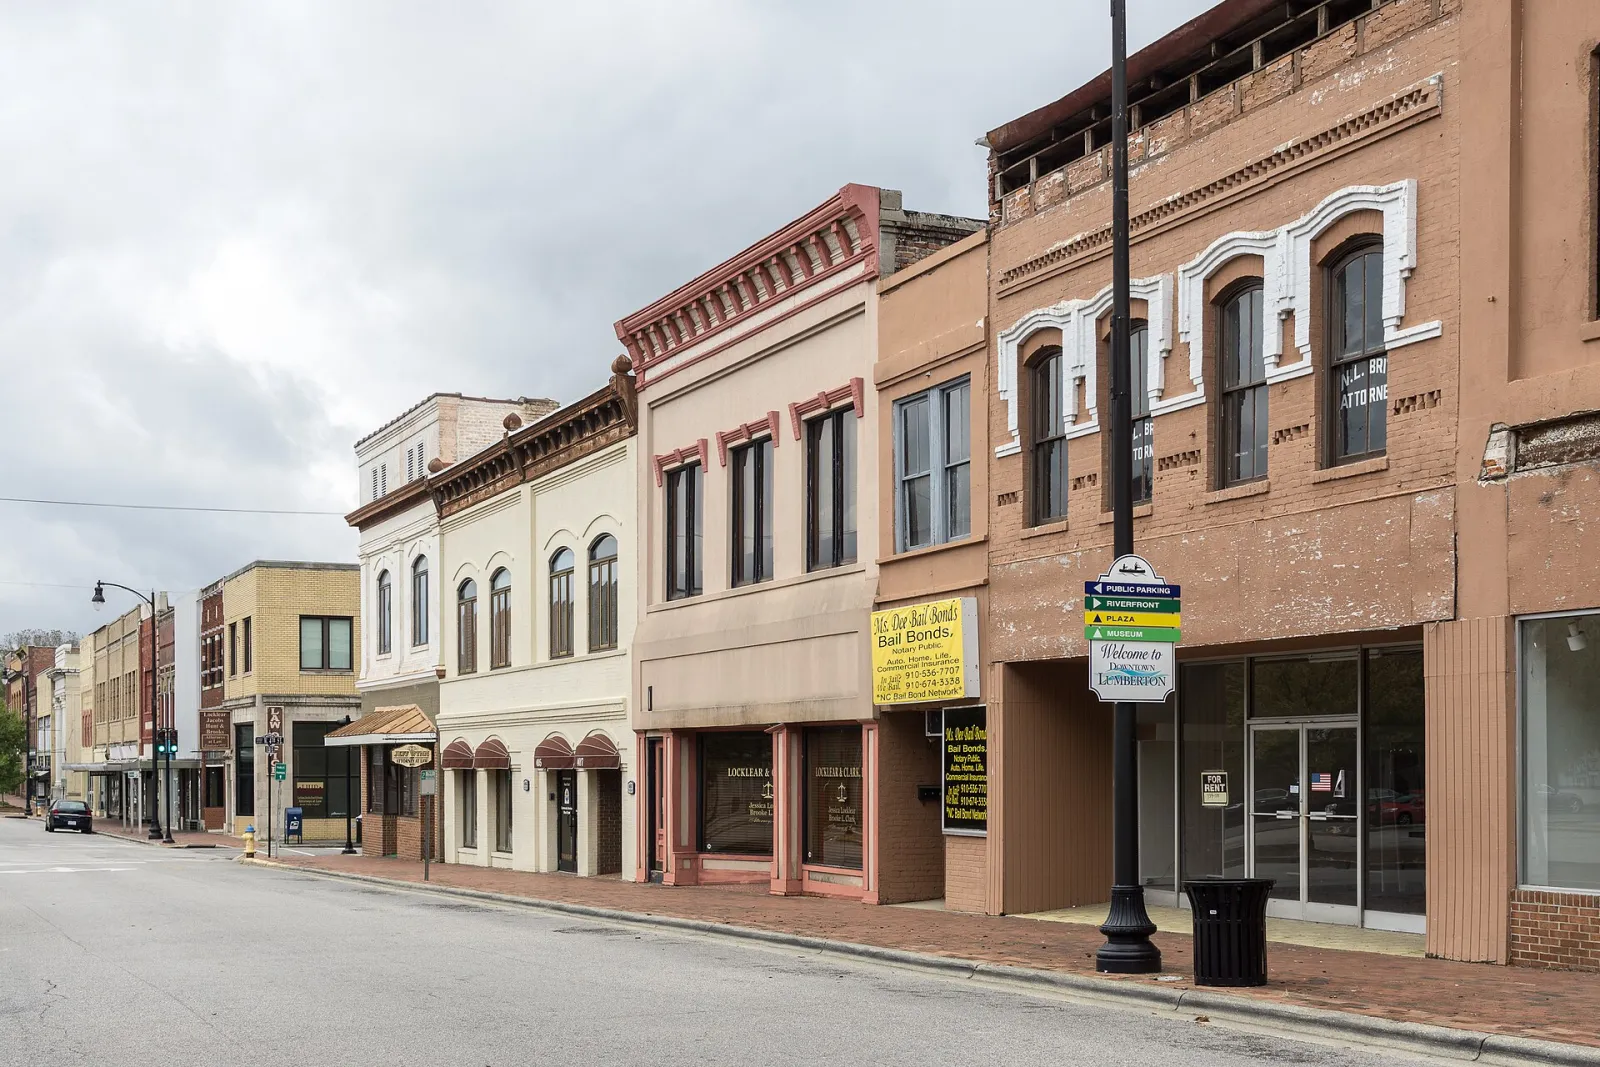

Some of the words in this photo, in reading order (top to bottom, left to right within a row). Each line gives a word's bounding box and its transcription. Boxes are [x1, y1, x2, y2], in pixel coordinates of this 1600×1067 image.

[1369, 358, 1388, 374] BRI
[1340, 384, 1388, 410] ATTORNE
[1136, 586, 1171, 594] PARKING
[1106, 600, 1160, 608] RIVERFRONT
[874, 617, 889, 636] Ms.
[892, 614, 908, 631] Dee
[909, 605, 930, 628] Bail
[930, 600, 958, 625] Bonds
[878, 633, 902, 648] Bail
[906, 626, 954, 644] Bonds,
[1106, 630, 1143, 638] MUSEUM
[892, 646, 917, 656] Notary
[1100, 644, 1149, 660] Welcome
[1150, 648, 1162, 660] to
[876, 662, 920, 673] Commercial
[922, 658, 960, 668] Insurance
[1110, 662, 1156, 671] DOWNTOWN
[905, 666, 960, 679] 910-536-7707
[906, 676, 961, 690] 910-674-3338
[1098, 672, 1166, 686] LUMBERTON
[893, 692, 906, 700] Bail
[908, 690, 926, 698] Bond
[270, 708, 281, 729] LAW
[948, 744, 961, 753] Bail
[954, 754, 966, 764] Notary
[728, 767, 763, 777] LOCKLEAR
[764, 767, 770, 777] &
[816, 767, 839, 777] LOCKLEAR
[840, 767, 843, 778] &
[946, 772, 968, 781] Commercial
[969, 773, 987, 781] Insuranc
[1207, 775, 1222, 784] FOR
[960, 784, 987, 794] 910-536-770
[1204, 783, 1226, 792] RENT
[960, 796, 987, 807] 910-674-333
[841, 806, 856, 814] Locklear
[962, 808, 972, 820] Bond
